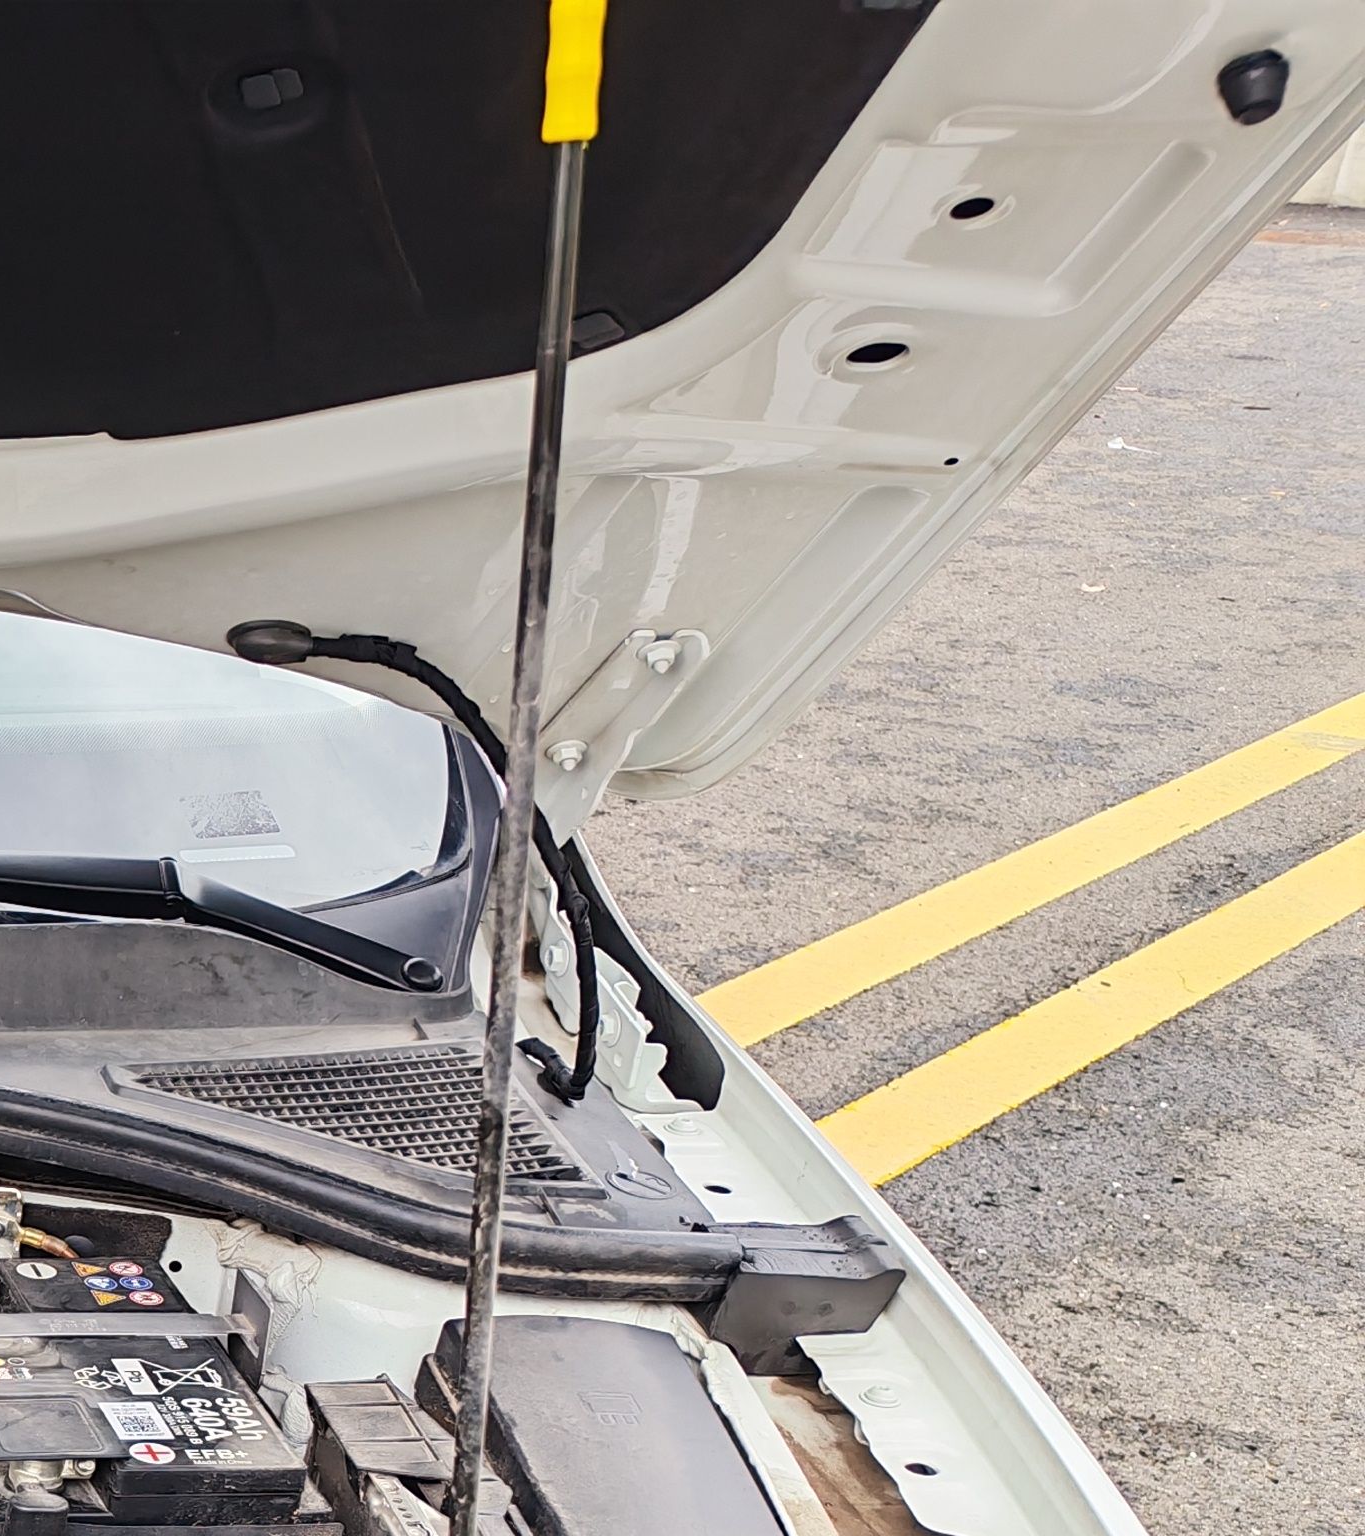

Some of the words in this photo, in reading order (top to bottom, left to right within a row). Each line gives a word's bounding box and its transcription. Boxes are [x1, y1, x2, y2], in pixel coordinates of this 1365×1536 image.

[123, 1369, 143, 1384] Pb
[180, 1396, 233, 1441] 640A
[215, 1396, 268, 1441] 59Ah
[184, 1449, 249, 1460] EFB+
